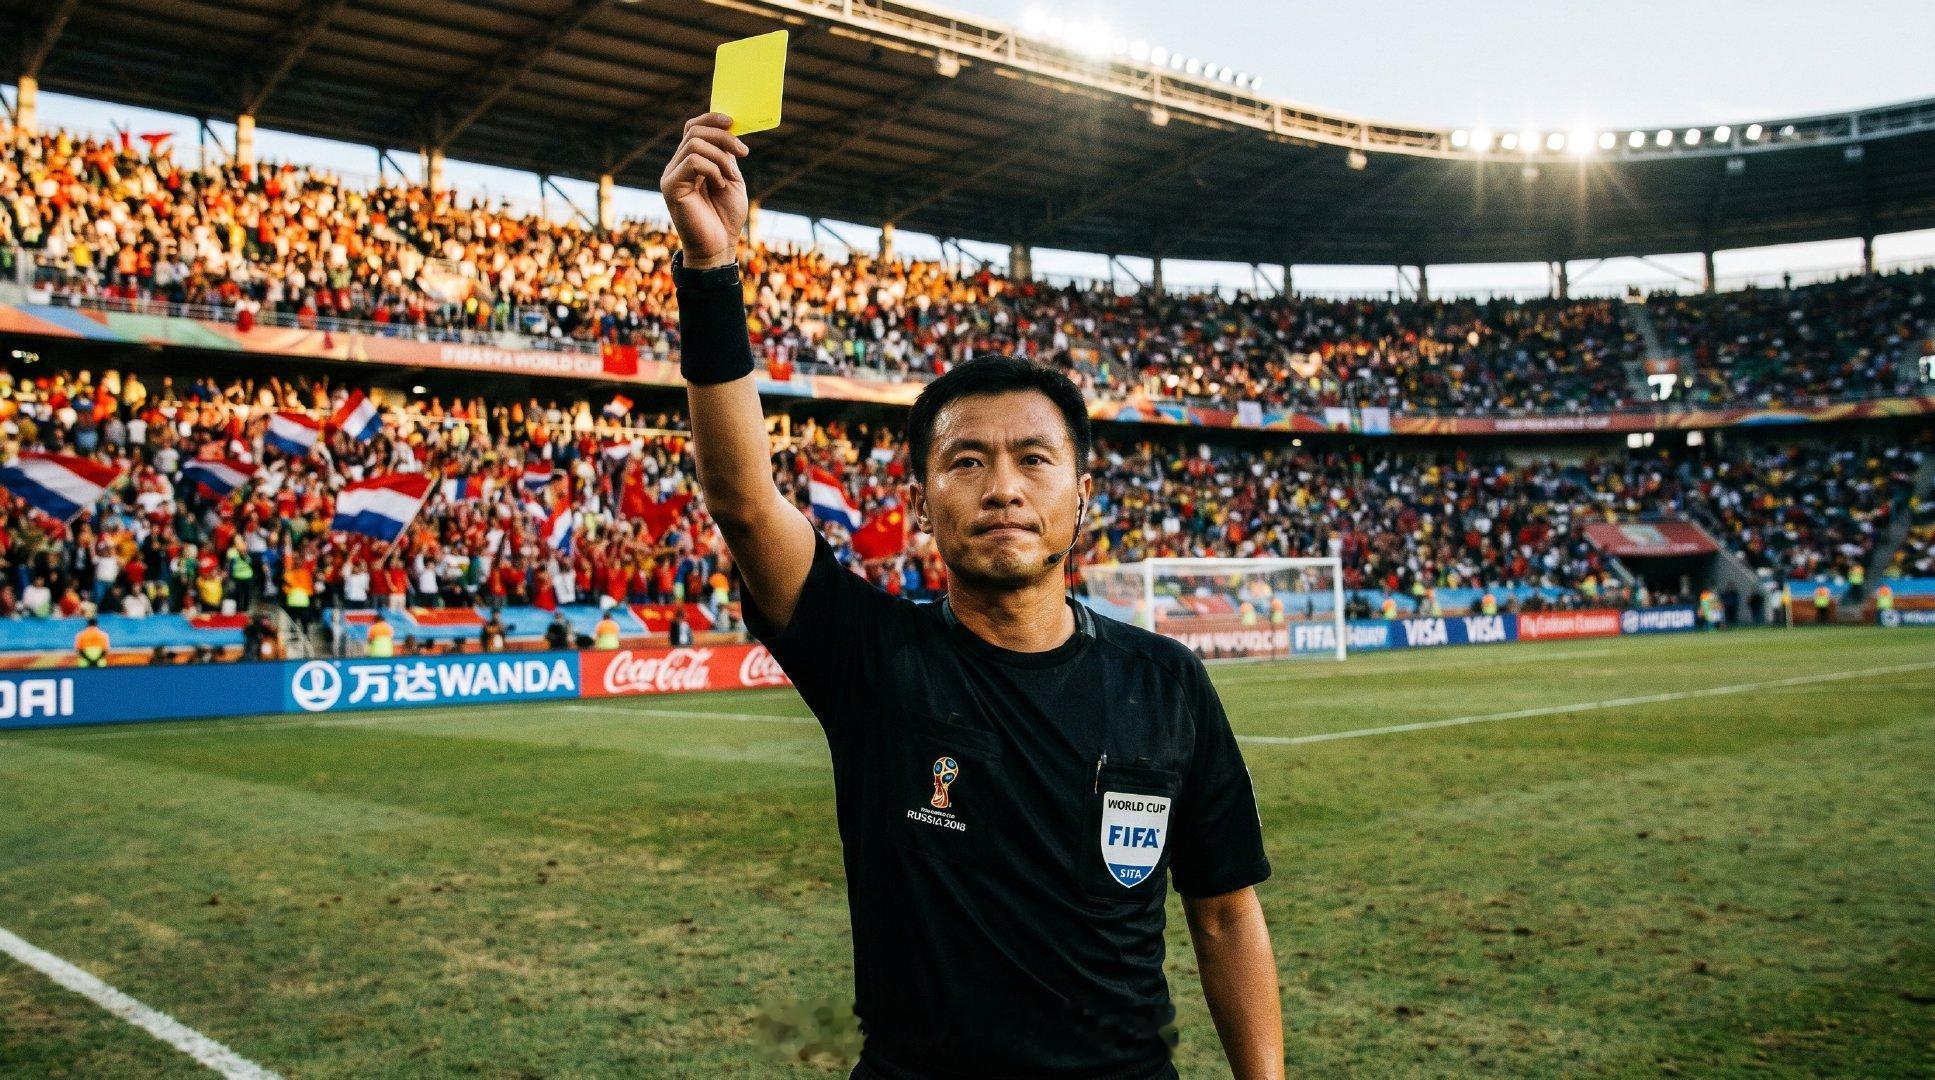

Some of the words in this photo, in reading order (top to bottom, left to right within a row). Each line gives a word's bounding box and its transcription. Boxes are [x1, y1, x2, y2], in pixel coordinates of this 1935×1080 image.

[574, 358, 602, 373] CU
[1403, 619, 1449, 645] VISA
[1463, 615, 1507, 642] VISA
[348, 662, 437, 704] 万达
[437, 659, 575, 697] WANDA
[603, 648, 714, 694] Coca-Cola
[1108, 799, 1144, 812] WORLD
[1146, 803, 1166, 813] CUP
[907, 810, 942, 826] RUSSIA
[943, 819, 966, 831] 2018
[1108, 825, 1159, 848] FIFA
[1120, 868, 1142, 879] SITA
